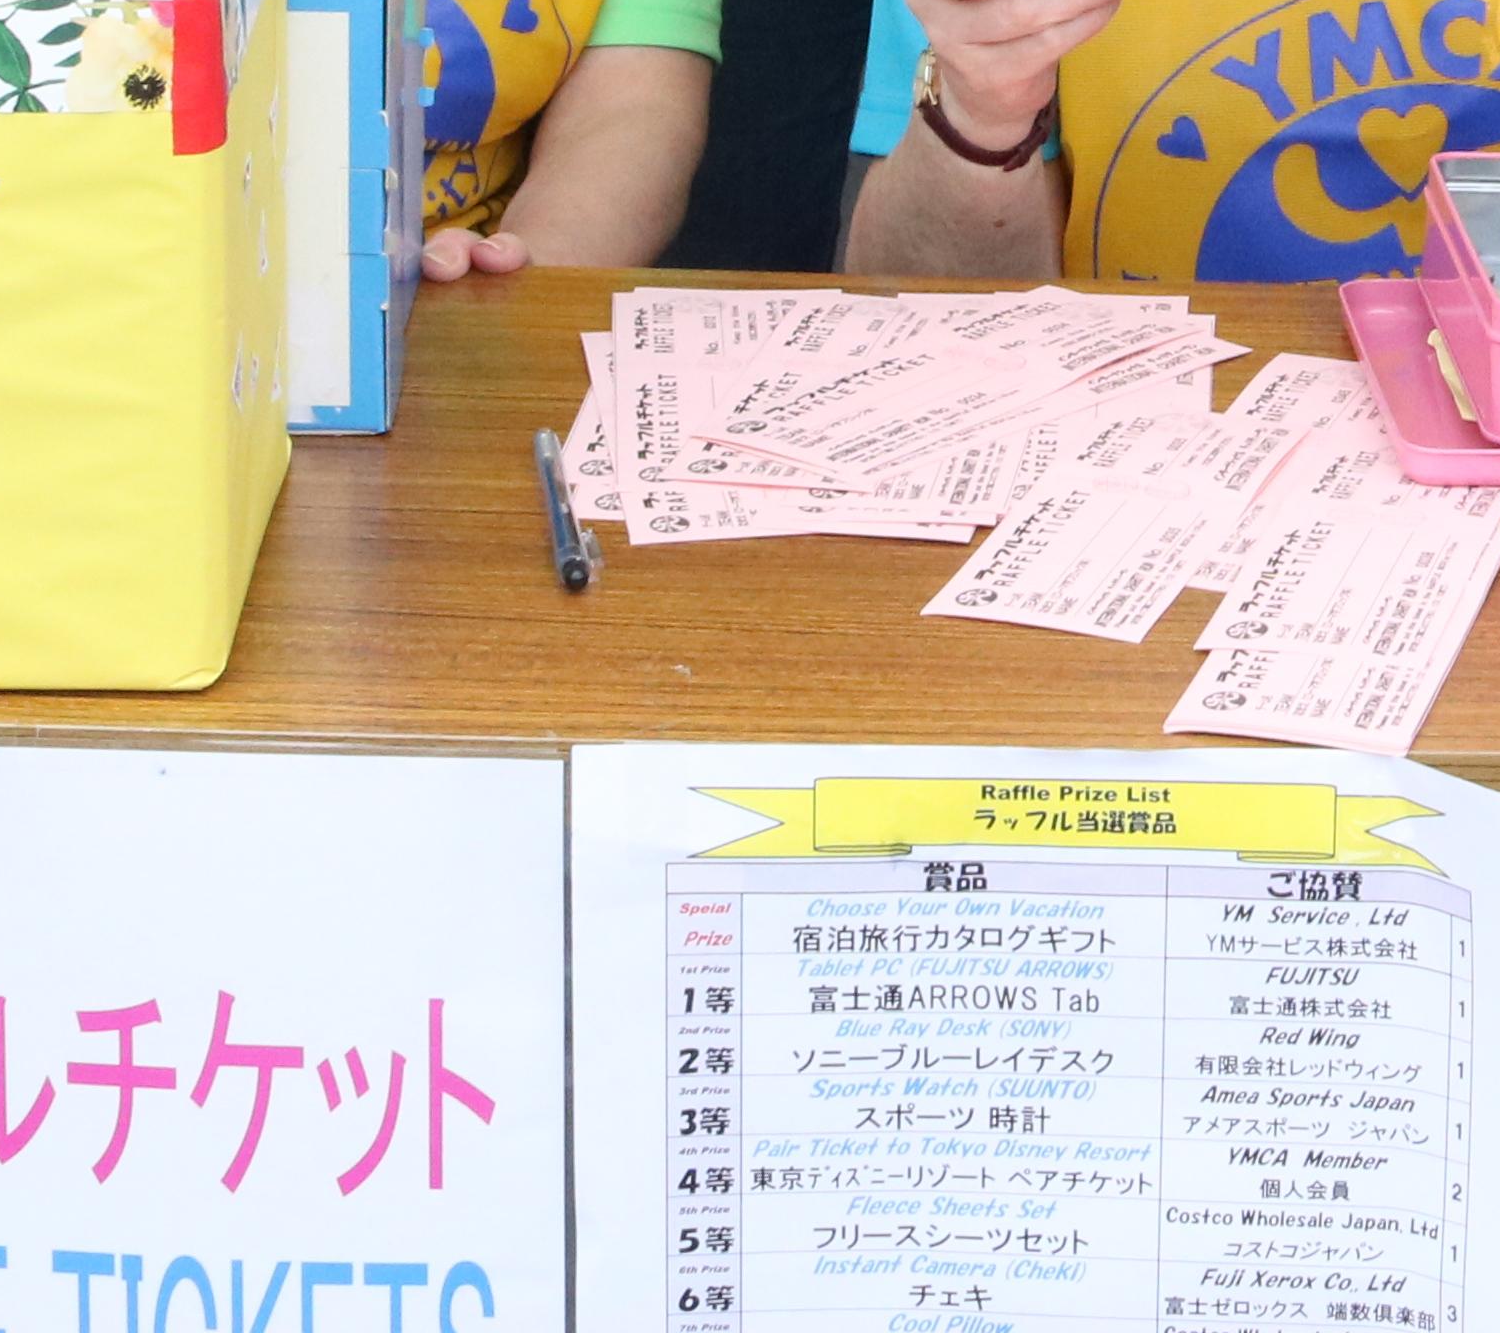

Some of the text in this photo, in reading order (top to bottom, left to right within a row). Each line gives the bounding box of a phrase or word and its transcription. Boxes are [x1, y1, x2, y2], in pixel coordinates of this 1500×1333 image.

[993, 488, 1092, 588] RAFFLE TICKET
[1259, 519, 1336, 619] RAFFLE TICKET
[980, 785, 1172, 804] Raffle Prize List
[972, 808, 1178, 836] ラッフル当選賞品
[922, 861, 1365, 903] 賞品 ご協賛
[805, 897, 1106, 920] Choose Your Own Vacation
[1220, 905, 1410, 928] YM Ltd
[683, 930, 734, 948] Prize
[791, 924, 1118, 956] 宿泊旅行カタログギフト
[1205, 933, 1419, 962] YMサービス株式会社
[796, 957, 1116, 982] Tablet PC (FUJITSU ARROWS)
[1264, 966, 1360, 988] FUJITSU
[808, 985, 1102, 1015] 富士通ARROWS Tab
[1228, 995, 1394, 1021] 富士通株式会社
[834, 1018, 1074, 1041] Blue Ray Desk (SONY)
[1258, 1026, 1361, 1050] Red Wing
[792, 1044, 1116, 1076] ソニーブルーレイデスク
[1193, 1054, 1423, 1084] 有限会社レッドウィング
[808, 1077, 1098, 1103] Sports Watch (SUUNTO)
[1199, 1086, 1417, 1114] Amea Sports Japan
[854, 1104, 1053, 1135] スポーツ 時計
[1181, 1113, 1431, 1146] アメアスポーツ ジャパン
[751, 1138, 1154, 1164] Pair Ticket to Tokyo Disney Resort
[1227, 1147, 1390, 1171] YMCA Member
[1007, 1166, 1154, 1196] ペアチケット
[1259, 1177, 1352, 1202] 個人会員
[845, 1196, 1059, 1221] Fleece Sheets Set
[1165, 1206, 1440, 1241] Costco Wholesale Ltd
[811, 1222, 1090, 1254] フリースシーツセット
[1222, 1240, 1385, 1264] コストコジャパン
[813, 1254, 903, 1277] Instant
[908, 1255, 998, 1280] Camera
[1199, 1268, 1408, 1295] Fuji Xerox Ltd
[908, 1283, 993, 1311] チェキ
[1163, 1295, 1309, 1320] 富士ゼロックス
[887, 1312, 939, 1333] Cool
